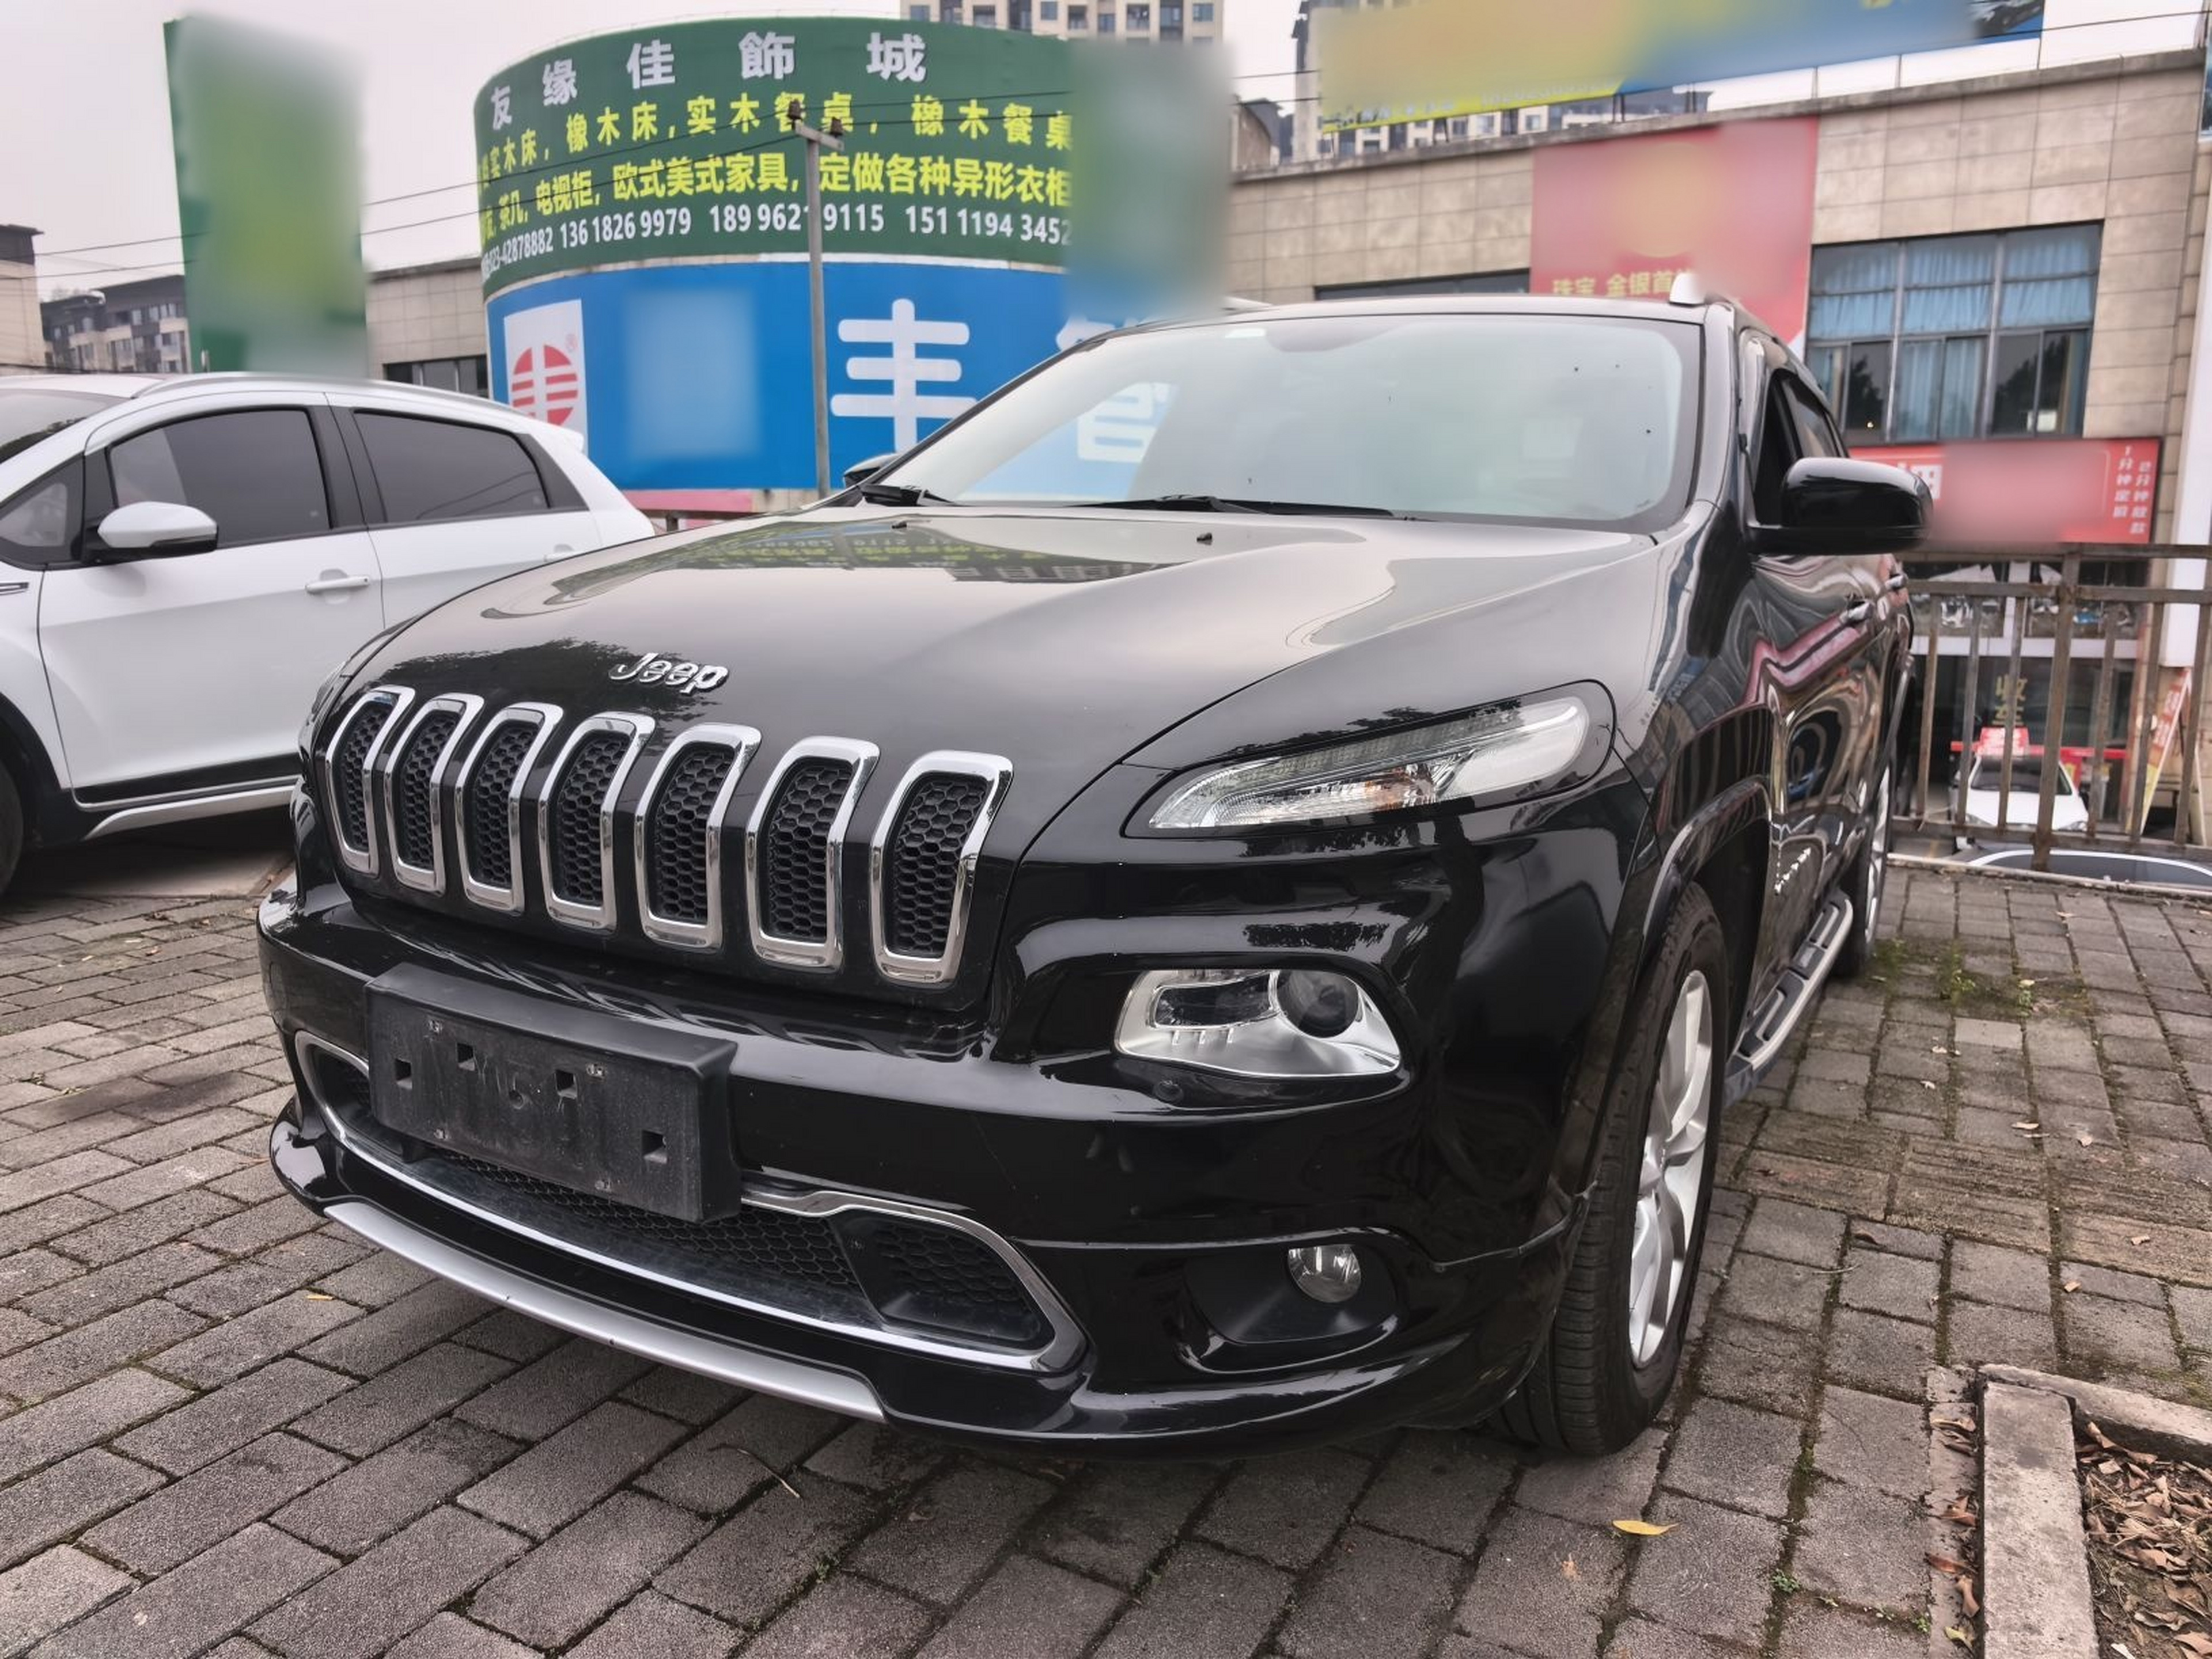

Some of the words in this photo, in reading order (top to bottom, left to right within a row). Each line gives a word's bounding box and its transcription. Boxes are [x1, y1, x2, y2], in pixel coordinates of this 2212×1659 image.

[560, 218, 588, 249] 136
[592, 211, 635, 243] 1826
[641, 207, 691, 237] 9979
[710, 204, 751, 233] 189
[823, 203, 884, 232] 9115
[906, 206, 946, 234] 151
[957, 208, 1013, 238] 1194
[608, 652, 729, 694] Jeep
